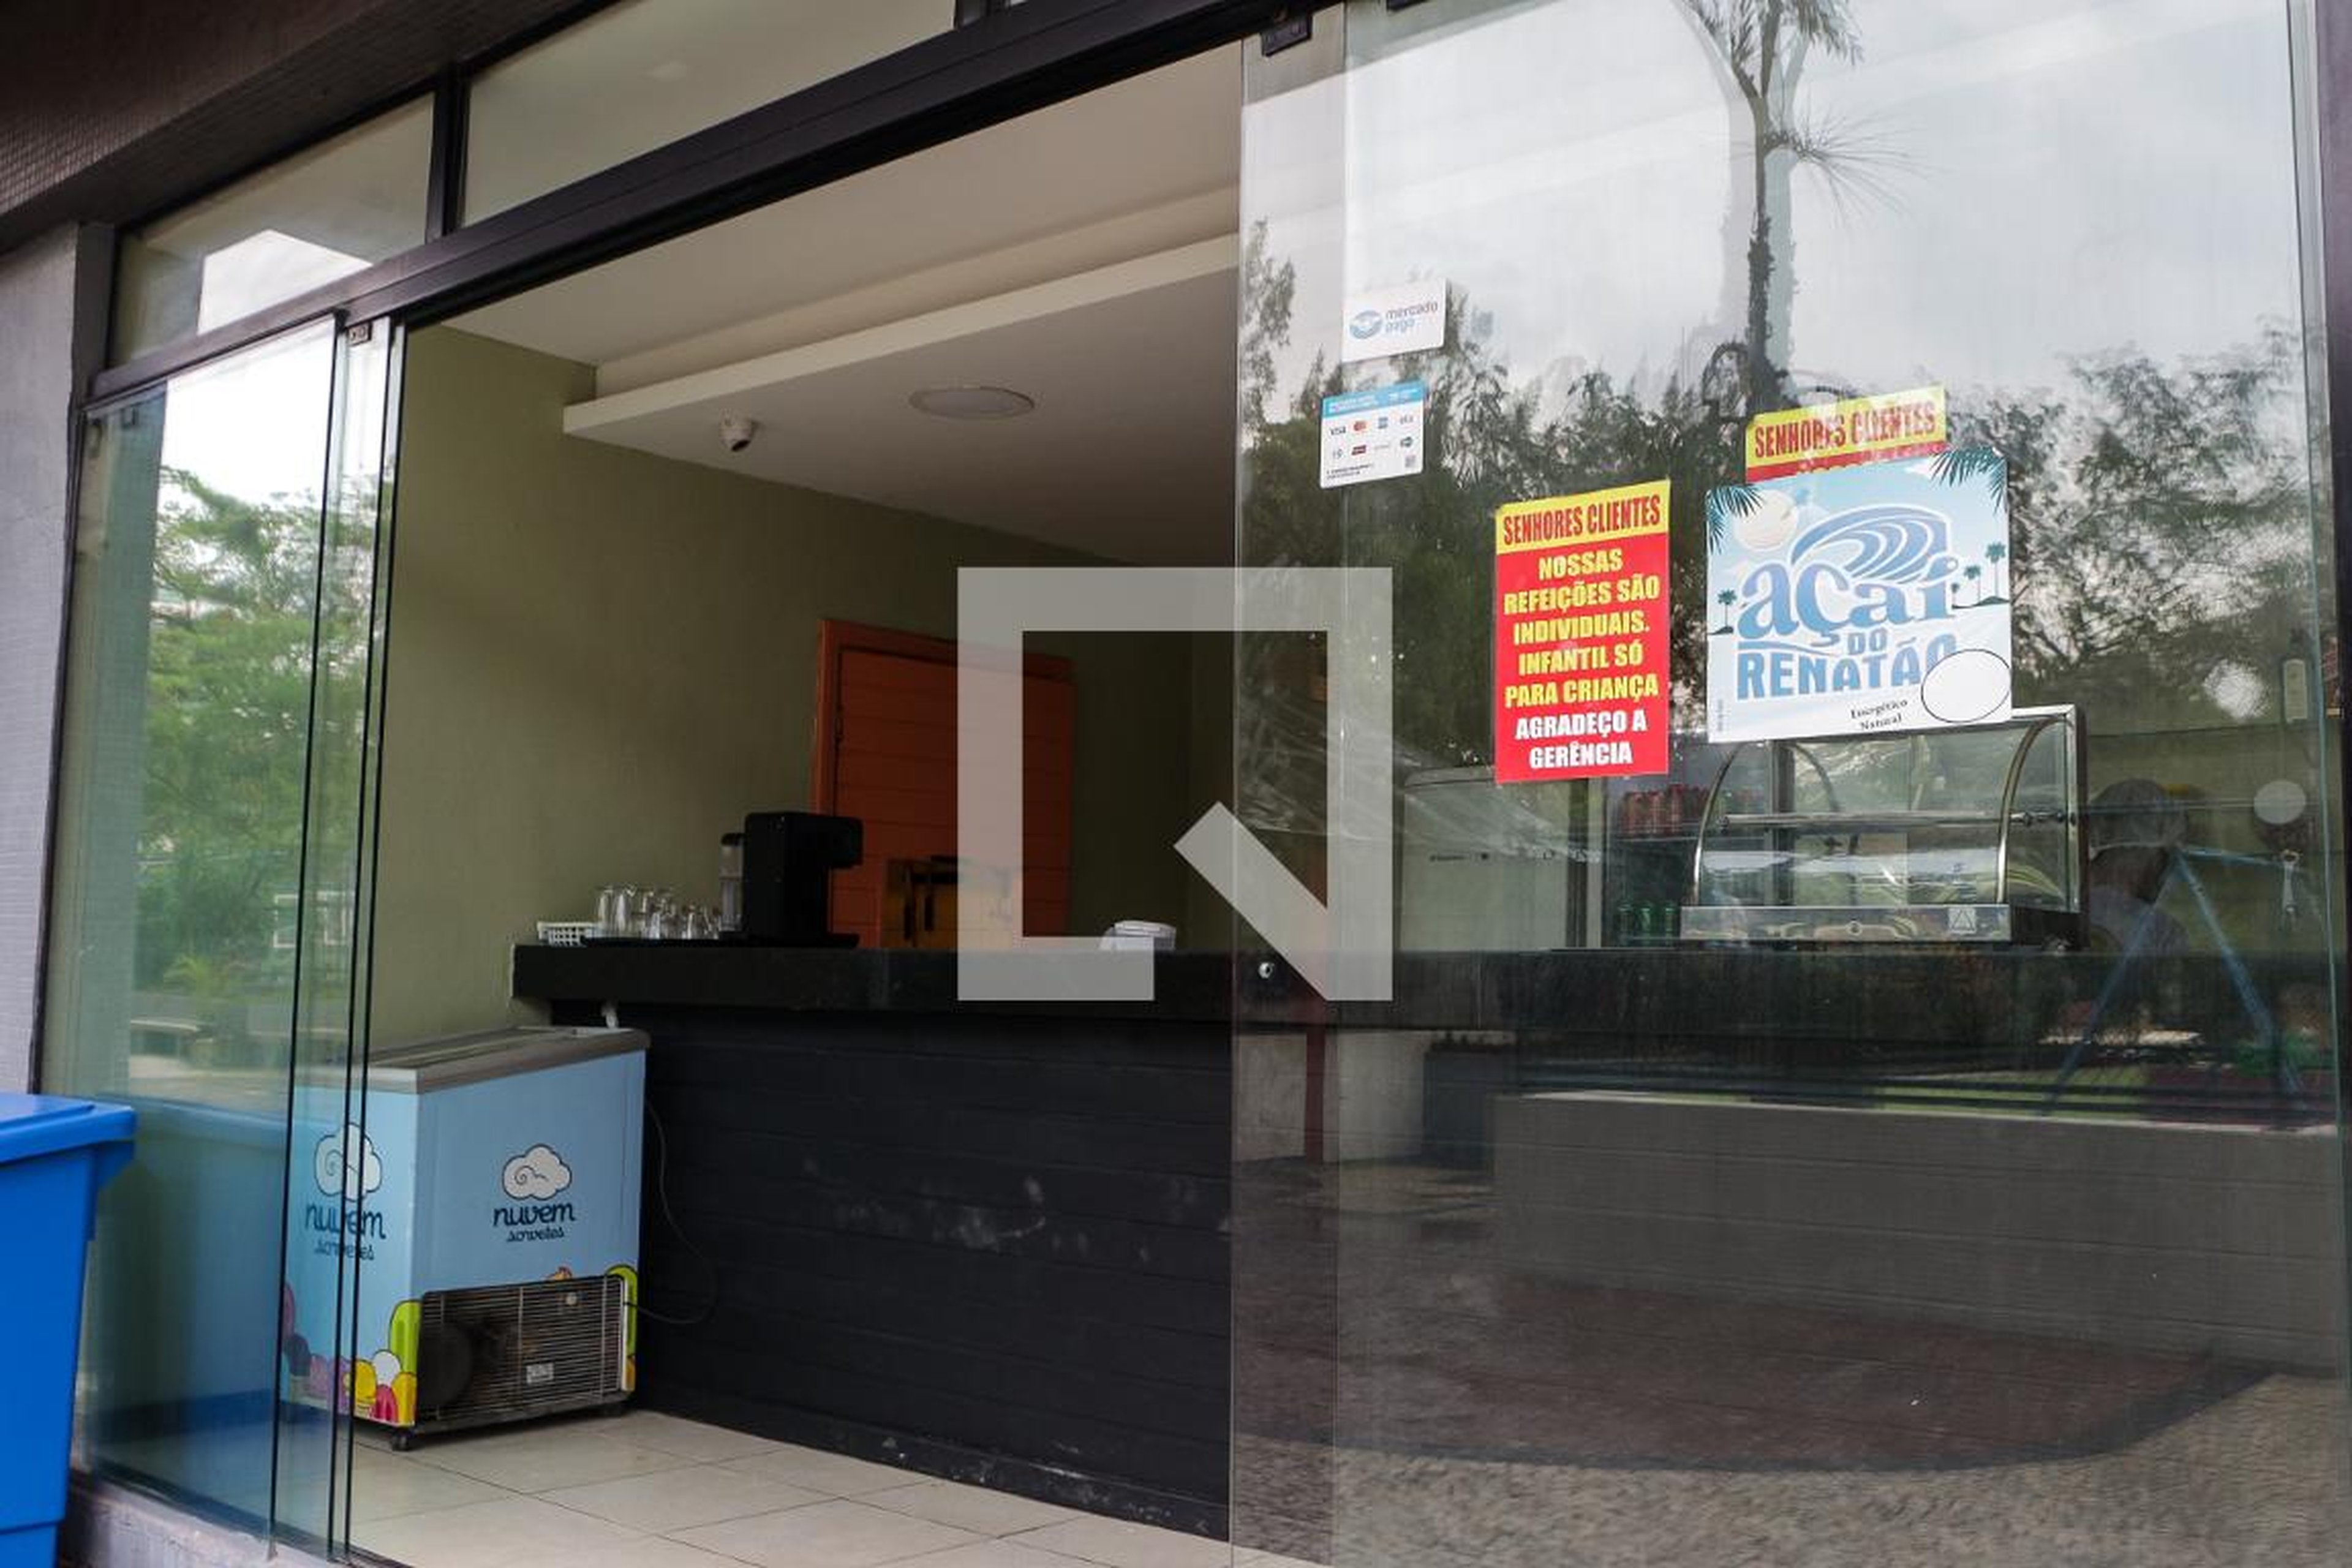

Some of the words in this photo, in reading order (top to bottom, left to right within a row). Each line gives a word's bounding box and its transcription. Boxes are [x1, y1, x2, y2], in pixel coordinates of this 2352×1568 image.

[1385, 301, 1438, 319] mercado
[1754, 415, 1846, 459] SENHORES
[1851, 401, 1936, 445] CLIENTES
[1503, 506, 1583, 546] SENHORES
[1587, 494, 1660, 535] CLIENTES
[1538, 548, 1623, 581] NOSSAS
[1504, 579, 1611, 616] REFEIÇÕES
[1616, 573, 1660, 603] SÃO
[1847, 627, 1888, 655] DO
[1518, 646, 1610, 677] INFANTIL
[1614, 639, 1643, 667] SÓ
[1504, 681, 1559, 709] PARA
[1562, 673, 1659, 703] CRIANÇA
[1515, 709, 1628, 741] AGRADEÇO
[1631, 708, 1648, 733] A
[1860, 712, 1902, 731] Natural
[1529, 740, 1634, 769] GERÊNCIA
[492, 1202, 577, 1228] nuvem
[314, 1238, 374, 1261] sorees
[506, 1225, 565, 1243] sorvetes
